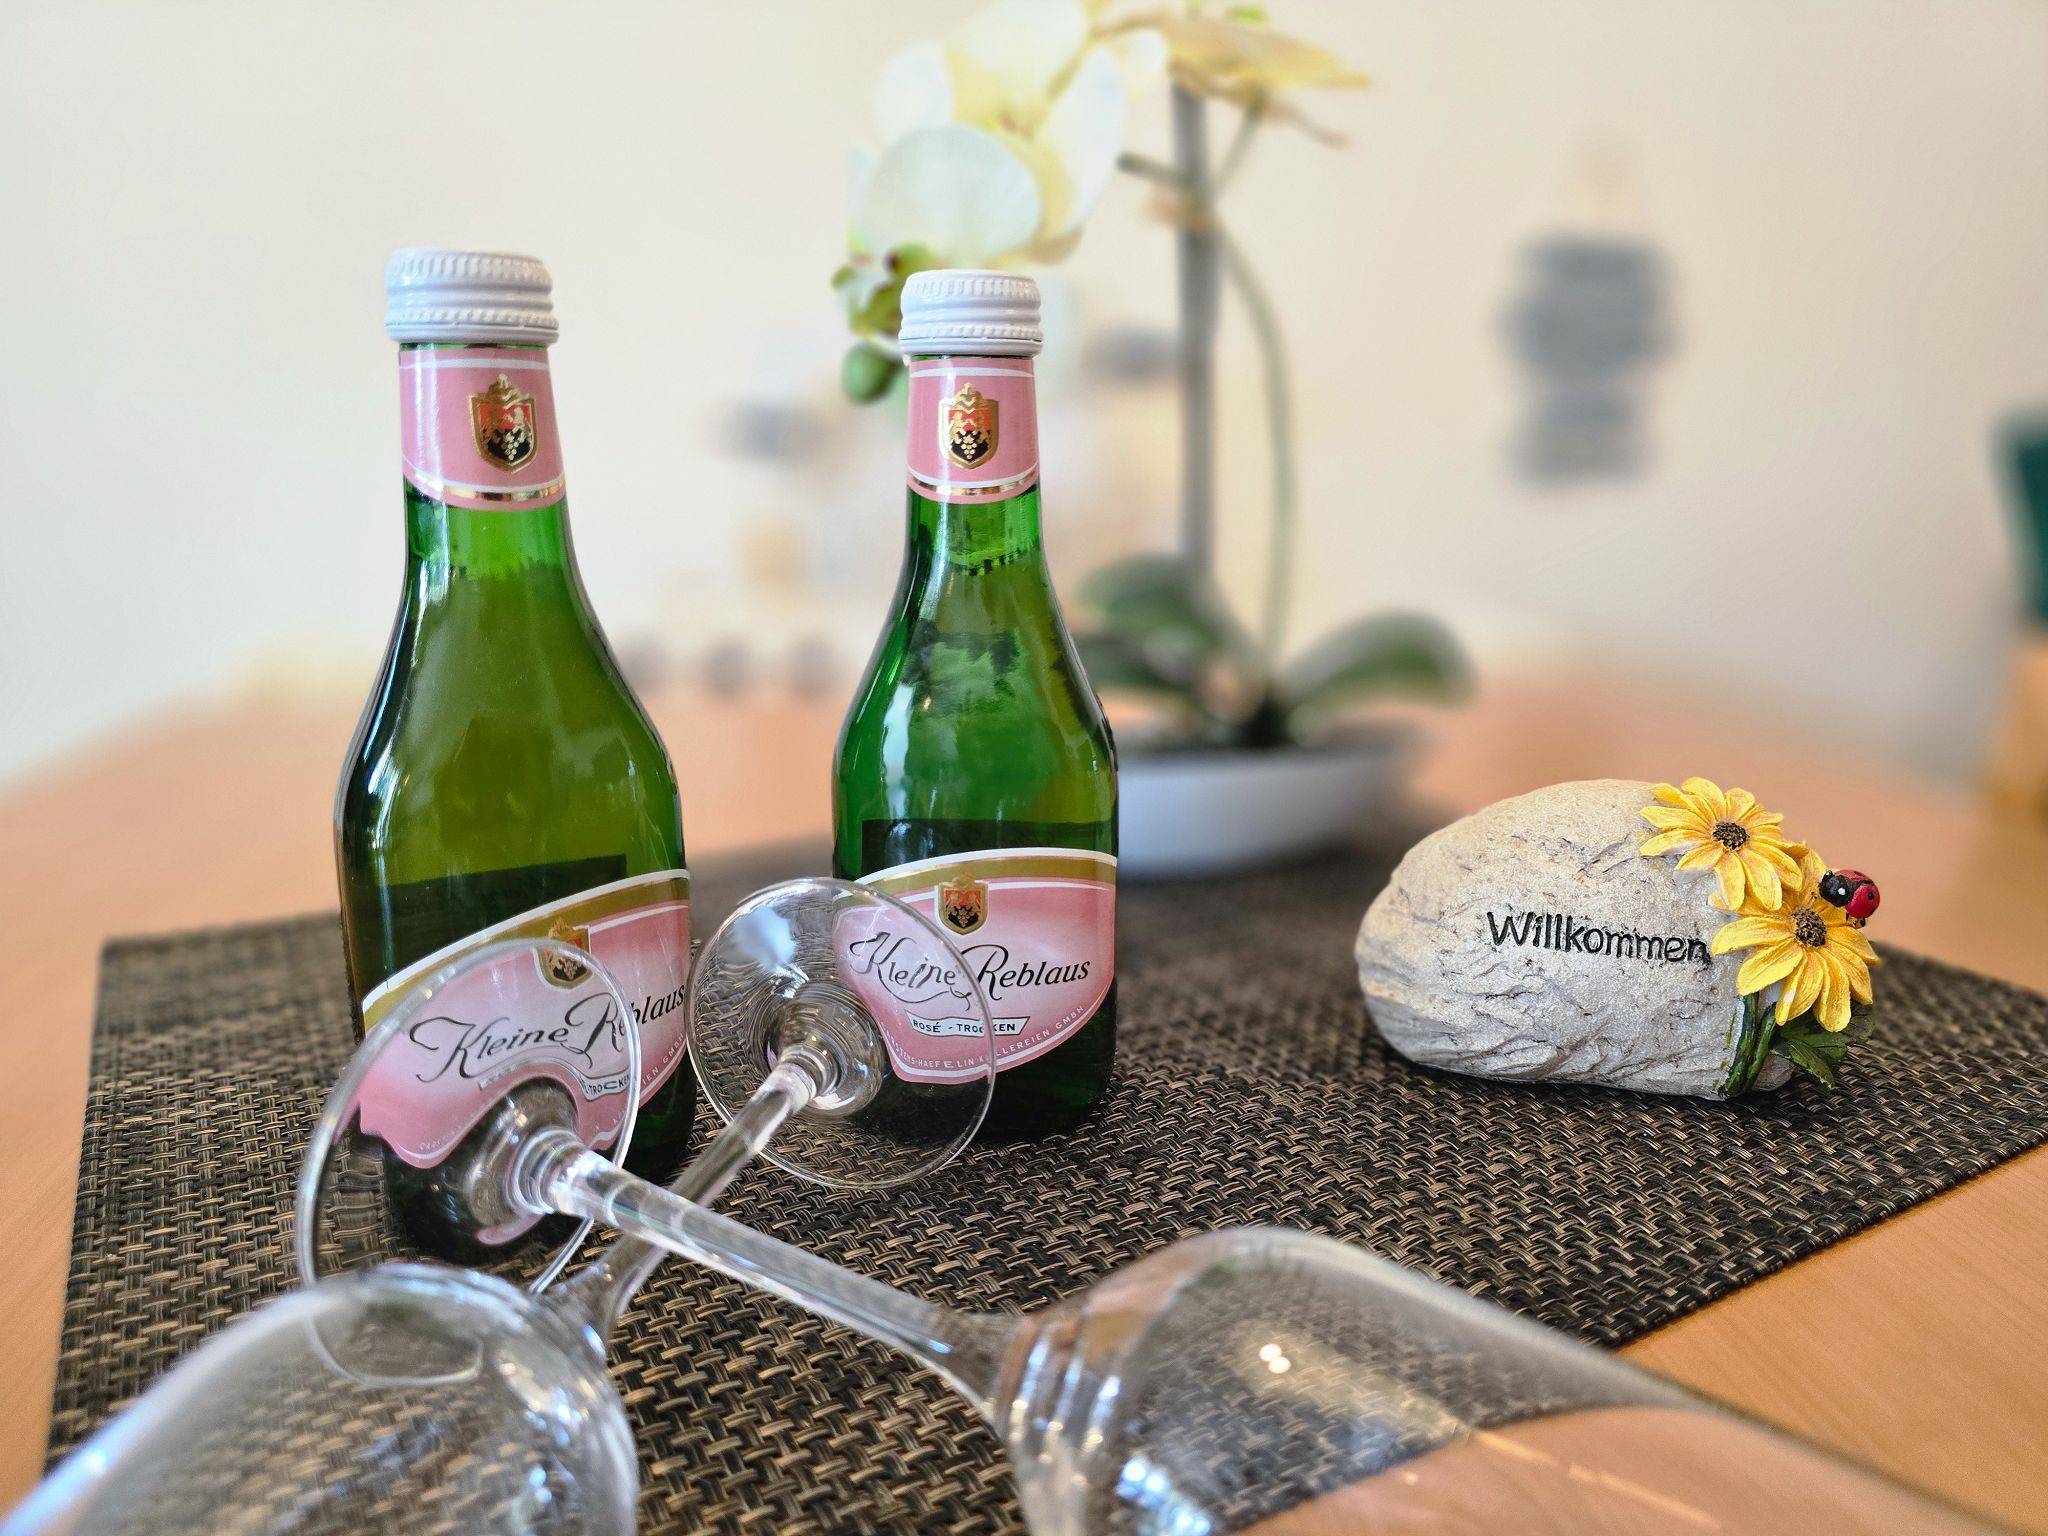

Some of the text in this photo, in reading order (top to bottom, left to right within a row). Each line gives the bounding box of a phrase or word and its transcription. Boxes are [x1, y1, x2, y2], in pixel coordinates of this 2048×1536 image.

[1486, 911, 1711, 964] Willkommen
[849, 931, 1091, 1011] Kleine Reblaus
[409, 986, 685, 1082] Kleine Reblaus
[912, 1020, 942, 1033] ROSÉ
[979, 1030, 1051, 1064] KLLEREIEN
[1055, 1005, 1084, 1030] GMBH
